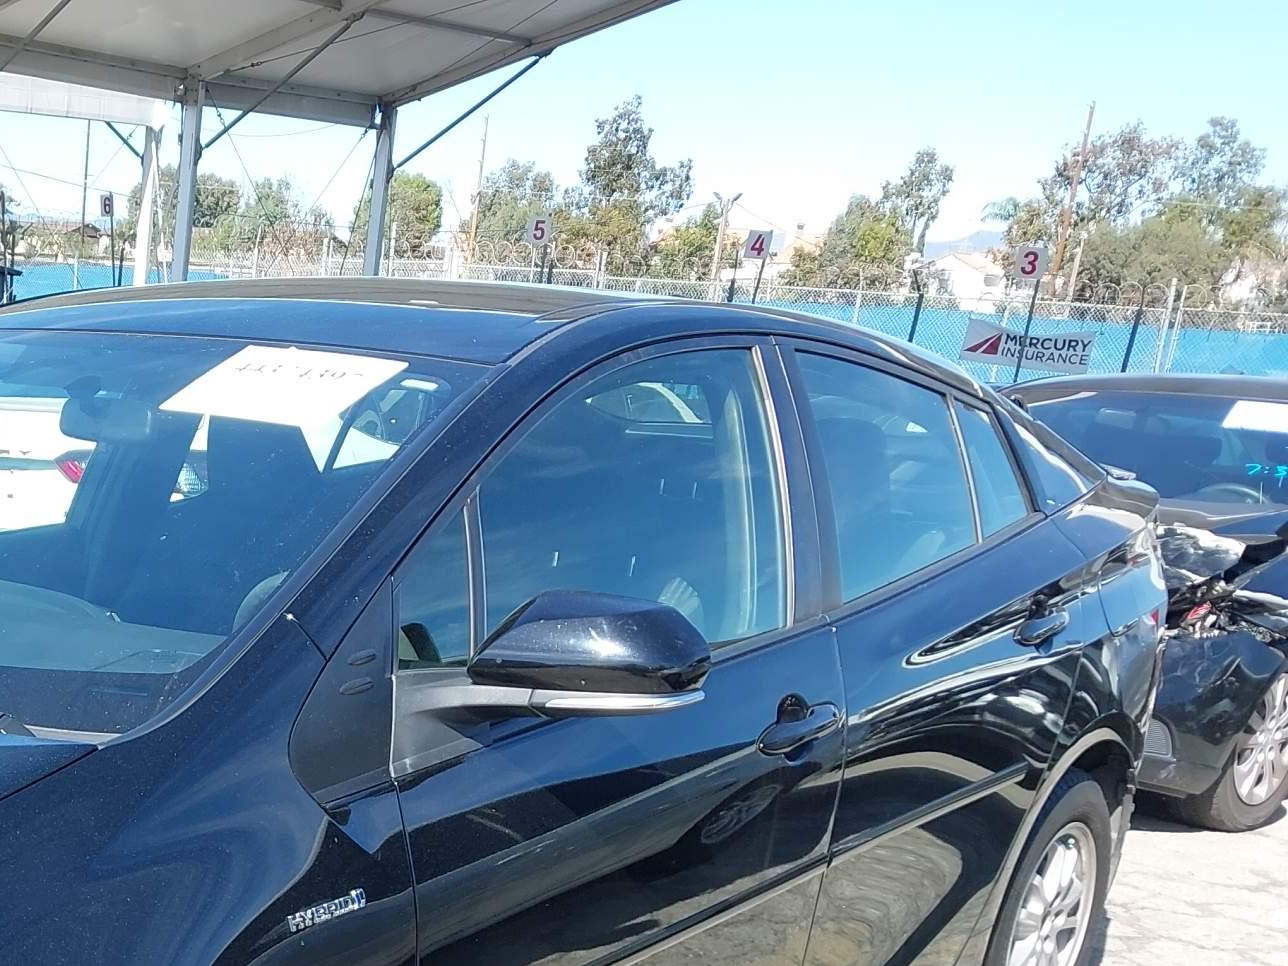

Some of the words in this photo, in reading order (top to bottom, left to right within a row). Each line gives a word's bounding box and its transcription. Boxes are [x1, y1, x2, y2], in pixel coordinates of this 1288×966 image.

[103, 197, 111, 214] 6
[532, 219, 546, 241] 5
[750, 233, 765, 256] 4
[1020, 250, 1039, 275] 3
[287, 895, 356, 932] HYBRID
